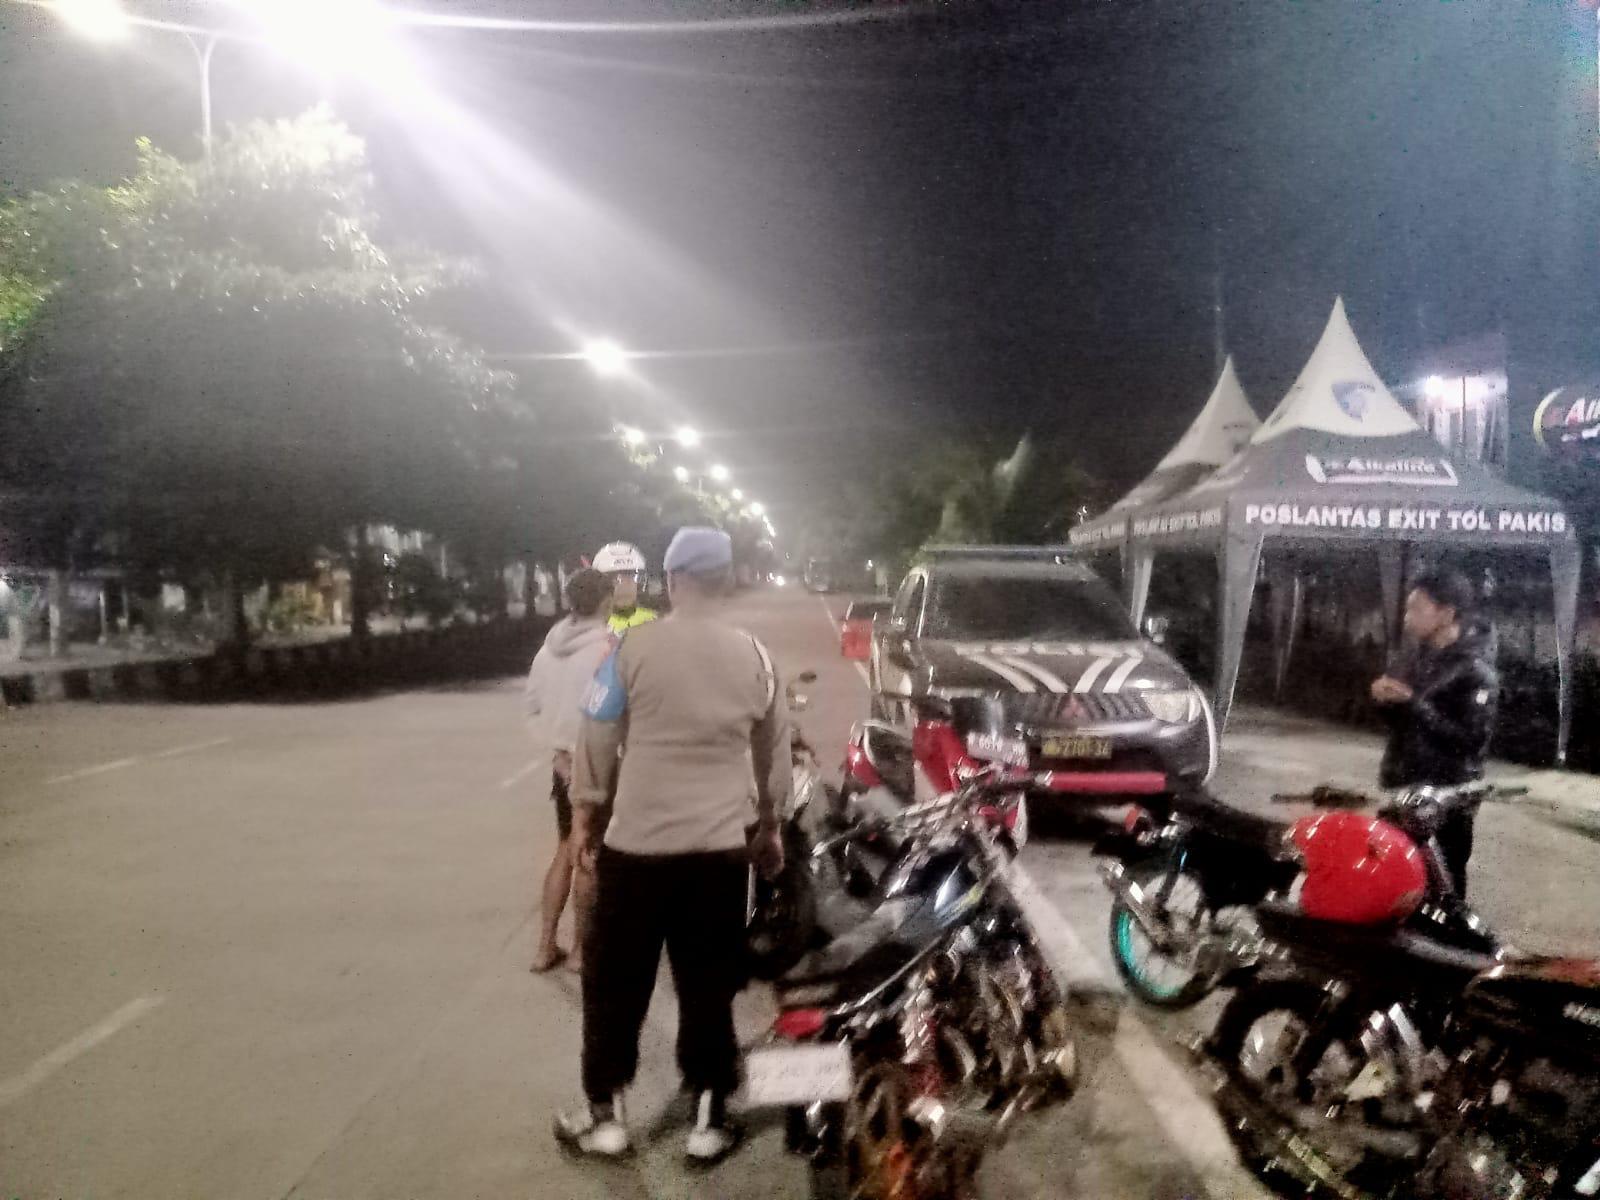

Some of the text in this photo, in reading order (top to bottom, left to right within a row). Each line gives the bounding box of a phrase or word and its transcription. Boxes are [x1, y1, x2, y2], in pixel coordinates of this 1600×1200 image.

[1245, 504, 1381, 528] POSLANTAS
[1388, 508, 1440, 530] EXIT
[1447, 509, 1491, 531] TOL
[1498, 511, 1566, 533] PAKIS
